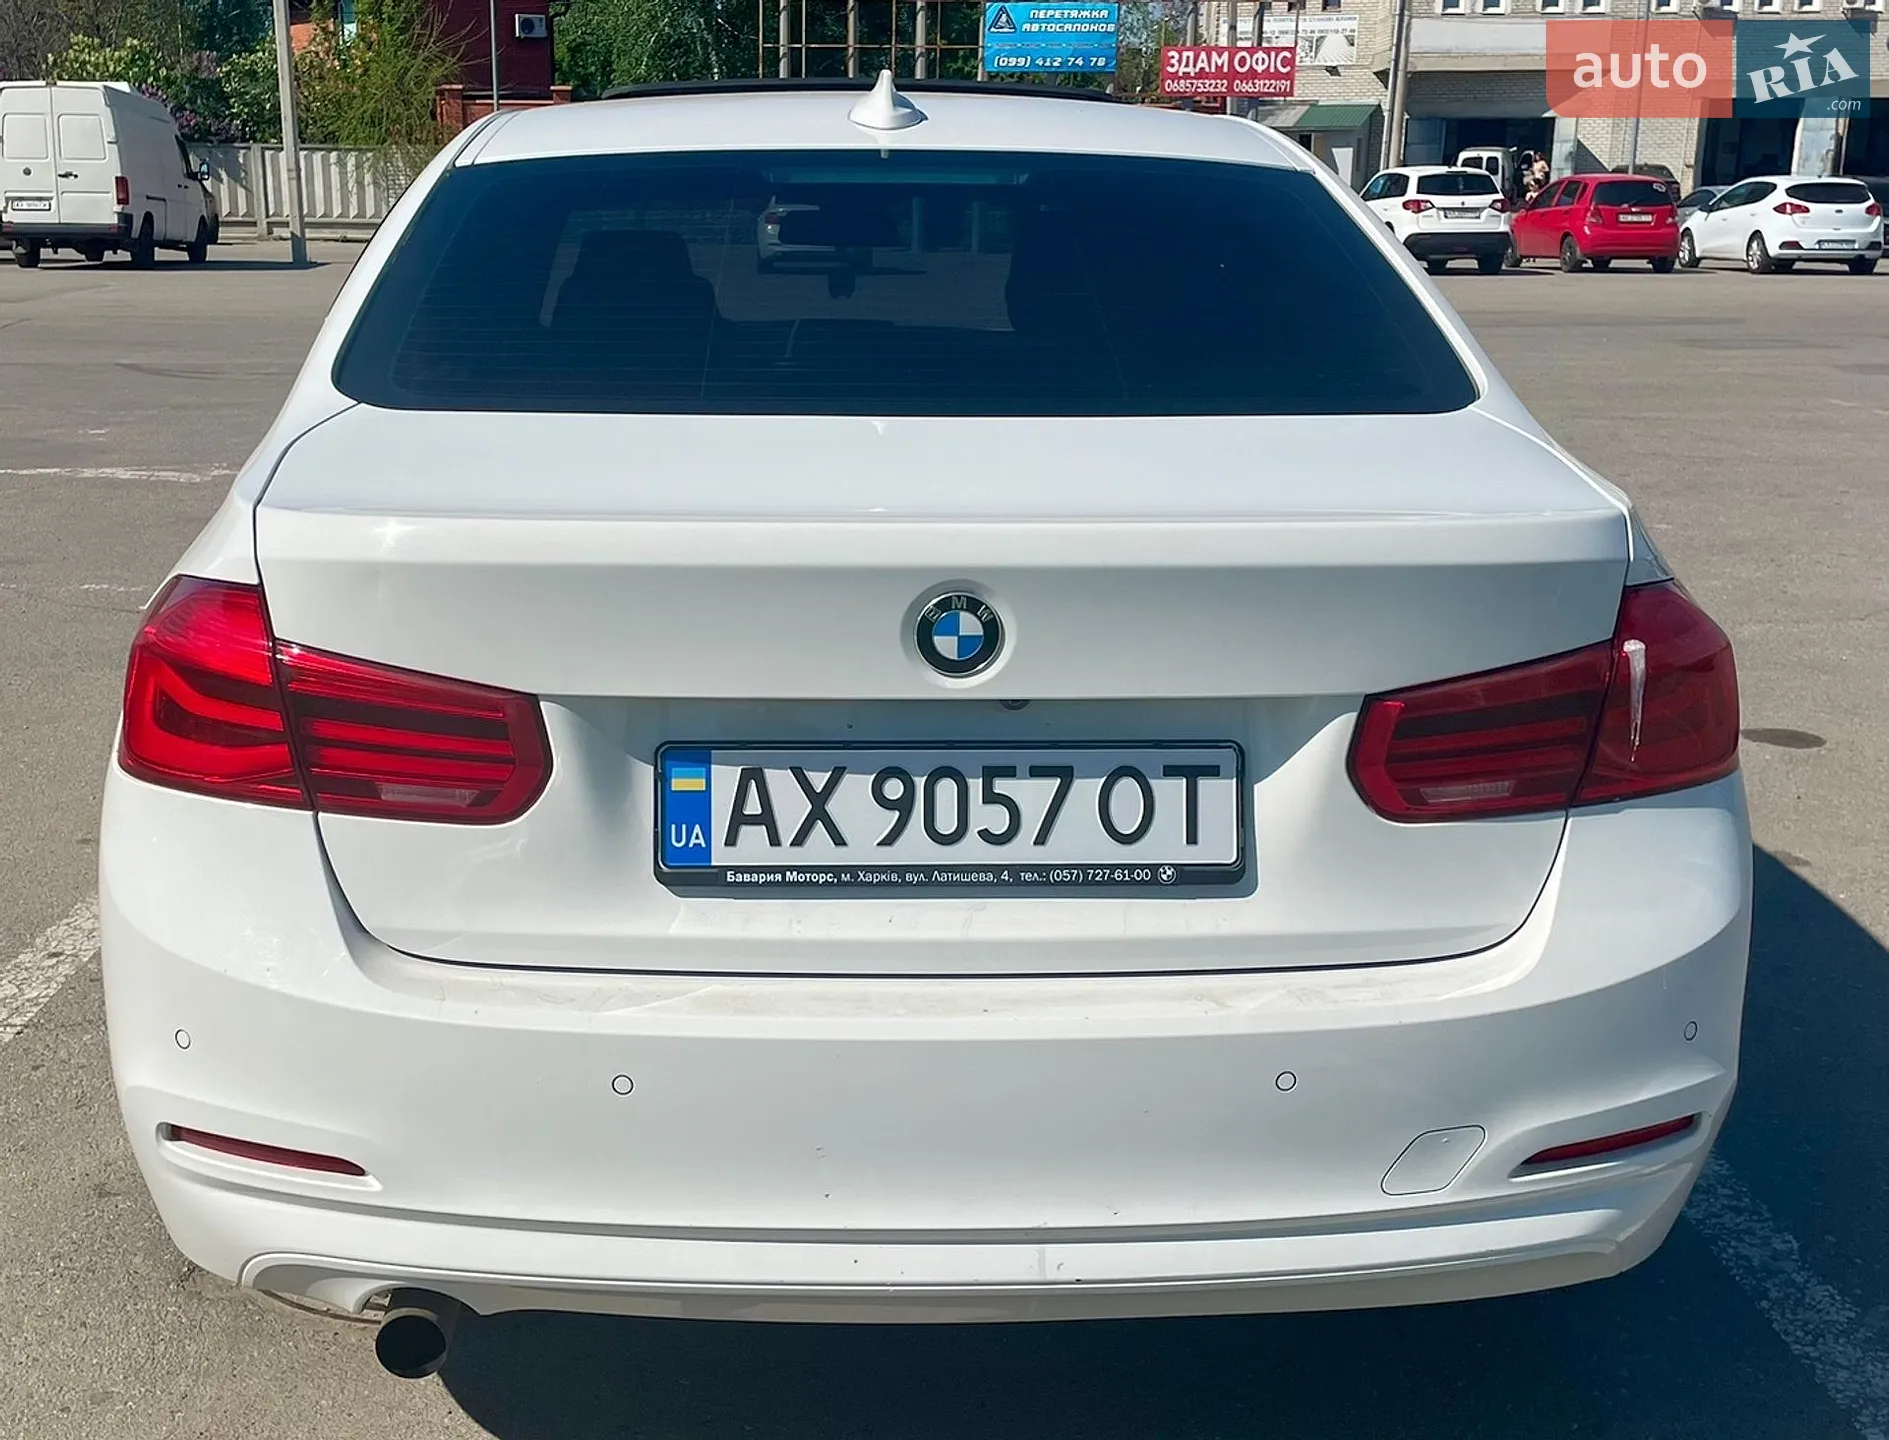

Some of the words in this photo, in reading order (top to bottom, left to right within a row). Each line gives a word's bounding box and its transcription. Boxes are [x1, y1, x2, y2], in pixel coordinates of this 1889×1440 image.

[1029, 9, 1109, 19] ПЕРЕТЯЖКА
[1022, 23, 1116, 32] АВТОСАЛОНОВ
[994, 56, 1031, 68] (099)
[1035, 57, 1061, 67] 412
[1067, 57, 1084, 67] 74
[1166, 50, 1229, 77] ЗДАМ
[1233, 50, 1292, 73] ОФІС
[1165, 79, 1228, 92] 0685753232
[924, 596, 994, 623] BMW
[724, 765, 848, 847] AX
[871, 765, 1075, 847] 9057
[1097, 765, 1221, 846] OT
[670, 823, 706, 848] UA
[726, 871, 782, 884] Бавария
[785, 871, 838, 884] Моторс,
[841, 873, 854, 882] м.
[858, 870, 902, 884] Харків,
[905, 872, 929, 884] вул.
[931, 870, 997, 883] Латишева,
[1019, 872, 1047, 882] тел.:
[1049, 869, 1083, 883] (057)
[1086, 869, 1151, 881] 727-61-00
